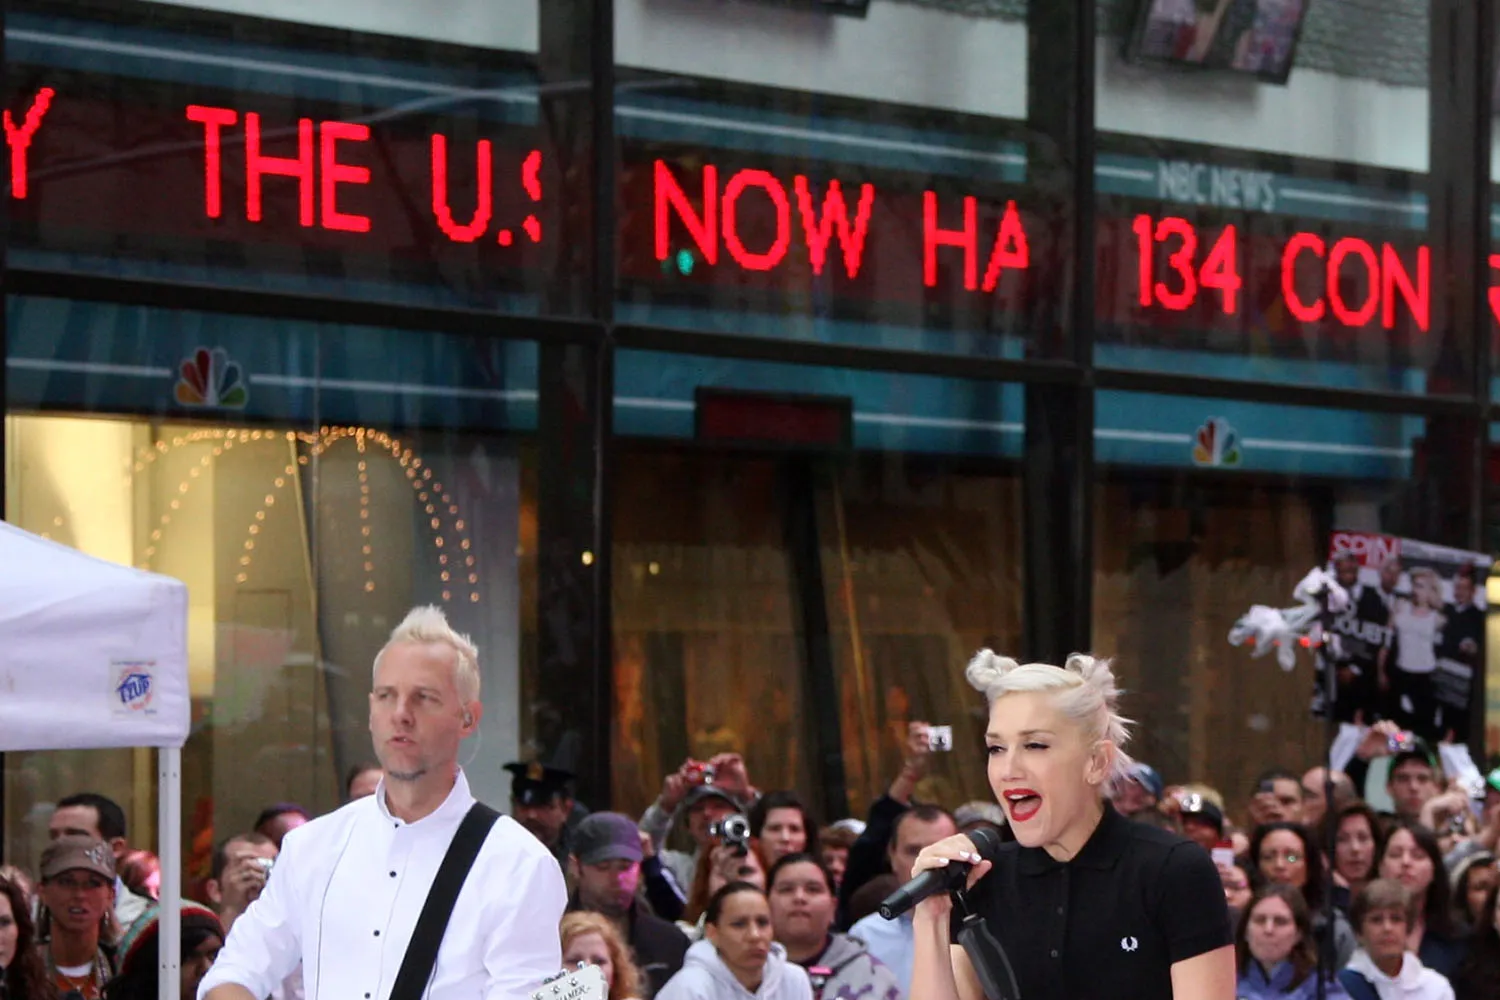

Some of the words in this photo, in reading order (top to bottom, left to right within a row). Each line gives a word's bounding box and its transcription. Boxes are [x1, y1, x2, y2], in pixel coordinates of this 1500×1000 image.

[1158, 160, 1200, 203] NBC
[1207, 168, 1275, 211] NEWS
[186, 104, 371, 233] THE
[654, 159, 875, 279] NOW
[923, 190, 1029, 292] HA
[1132, 214, 1242, 315] 134
[1332, 532, 1398, 566] SPIN
[1334, 615, 1394, 648] OUBT
